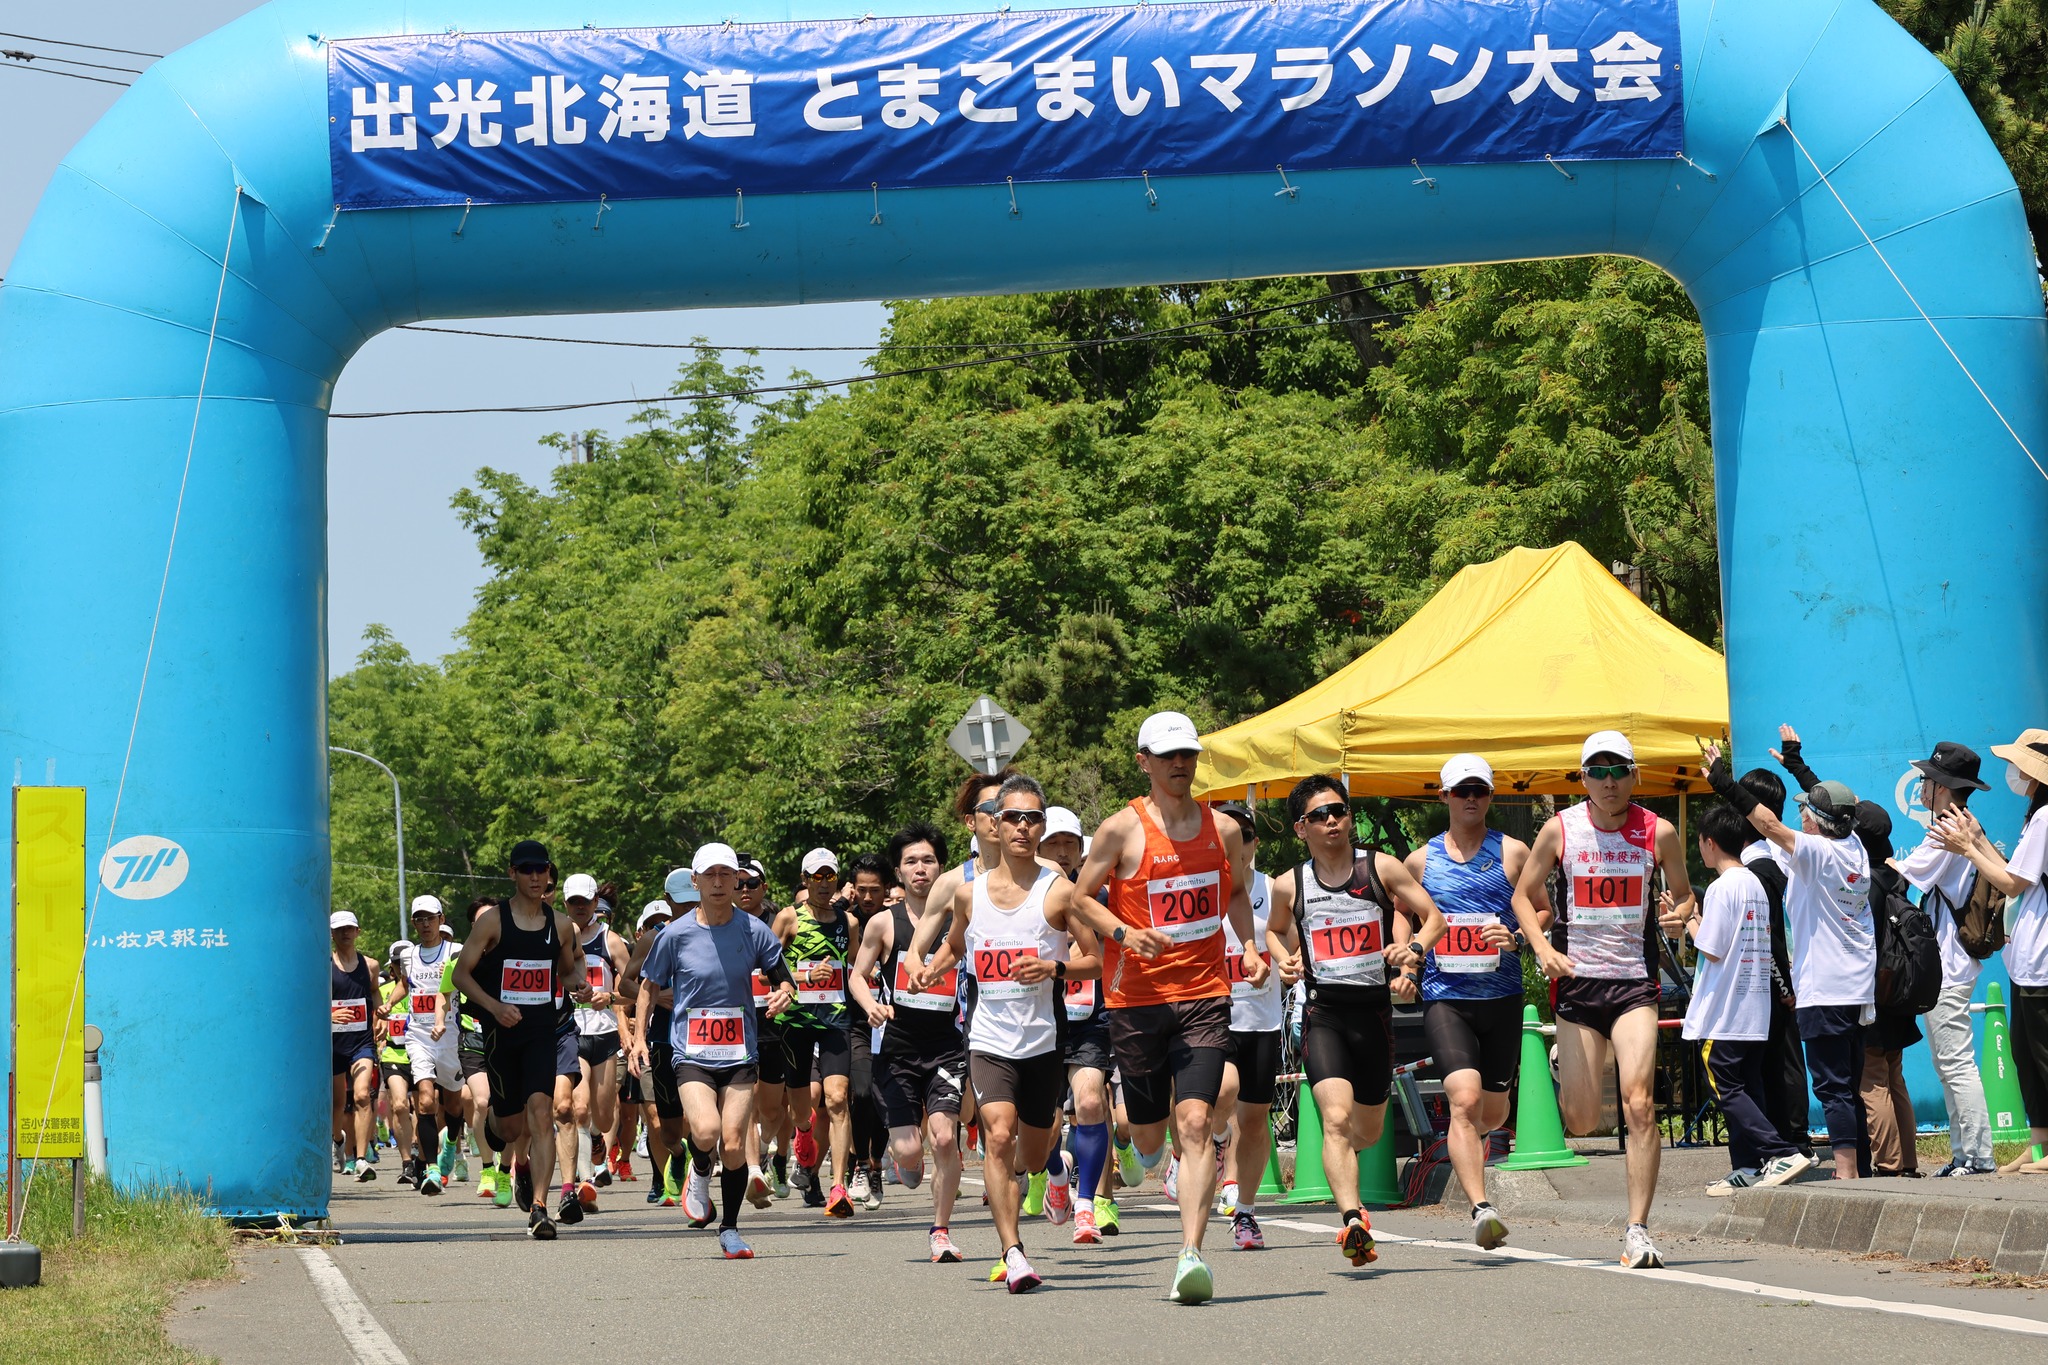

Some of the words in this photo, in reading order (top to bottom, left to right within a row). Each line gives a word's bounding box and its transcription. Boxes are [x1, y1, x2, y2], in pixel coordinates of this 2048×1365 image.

[351, 69, 757, 153] 出光北海道
[802, 31, 1664, 133] とまこまいマラソン大会
[1577, 850, 1642, 864] 滝川市役所
[1599, 866, 1629, 874] idemitsu
[1176, 876, 1206, 888] idemitsu
[1584, 877, 1629, 905] 101
[1161, 887, 1210, 922] 206
[1335, 914, 1365, 925] idemitsu
[85, 927, 229, 949] 小牧民報社
[994, 939, 1024, 947] idemitsu
[1323, 924, 1373, 956] 102
[1447, 926, 1489, 953] 103
[523, 960, 543, 968] idemitsu
[509, 969, 545, 990] 209
[417, 995, 436, 1012] 40
[696, 1018, 737, 1043] 408
[20, 1117, 81, 1130] 苫小牧警察署
